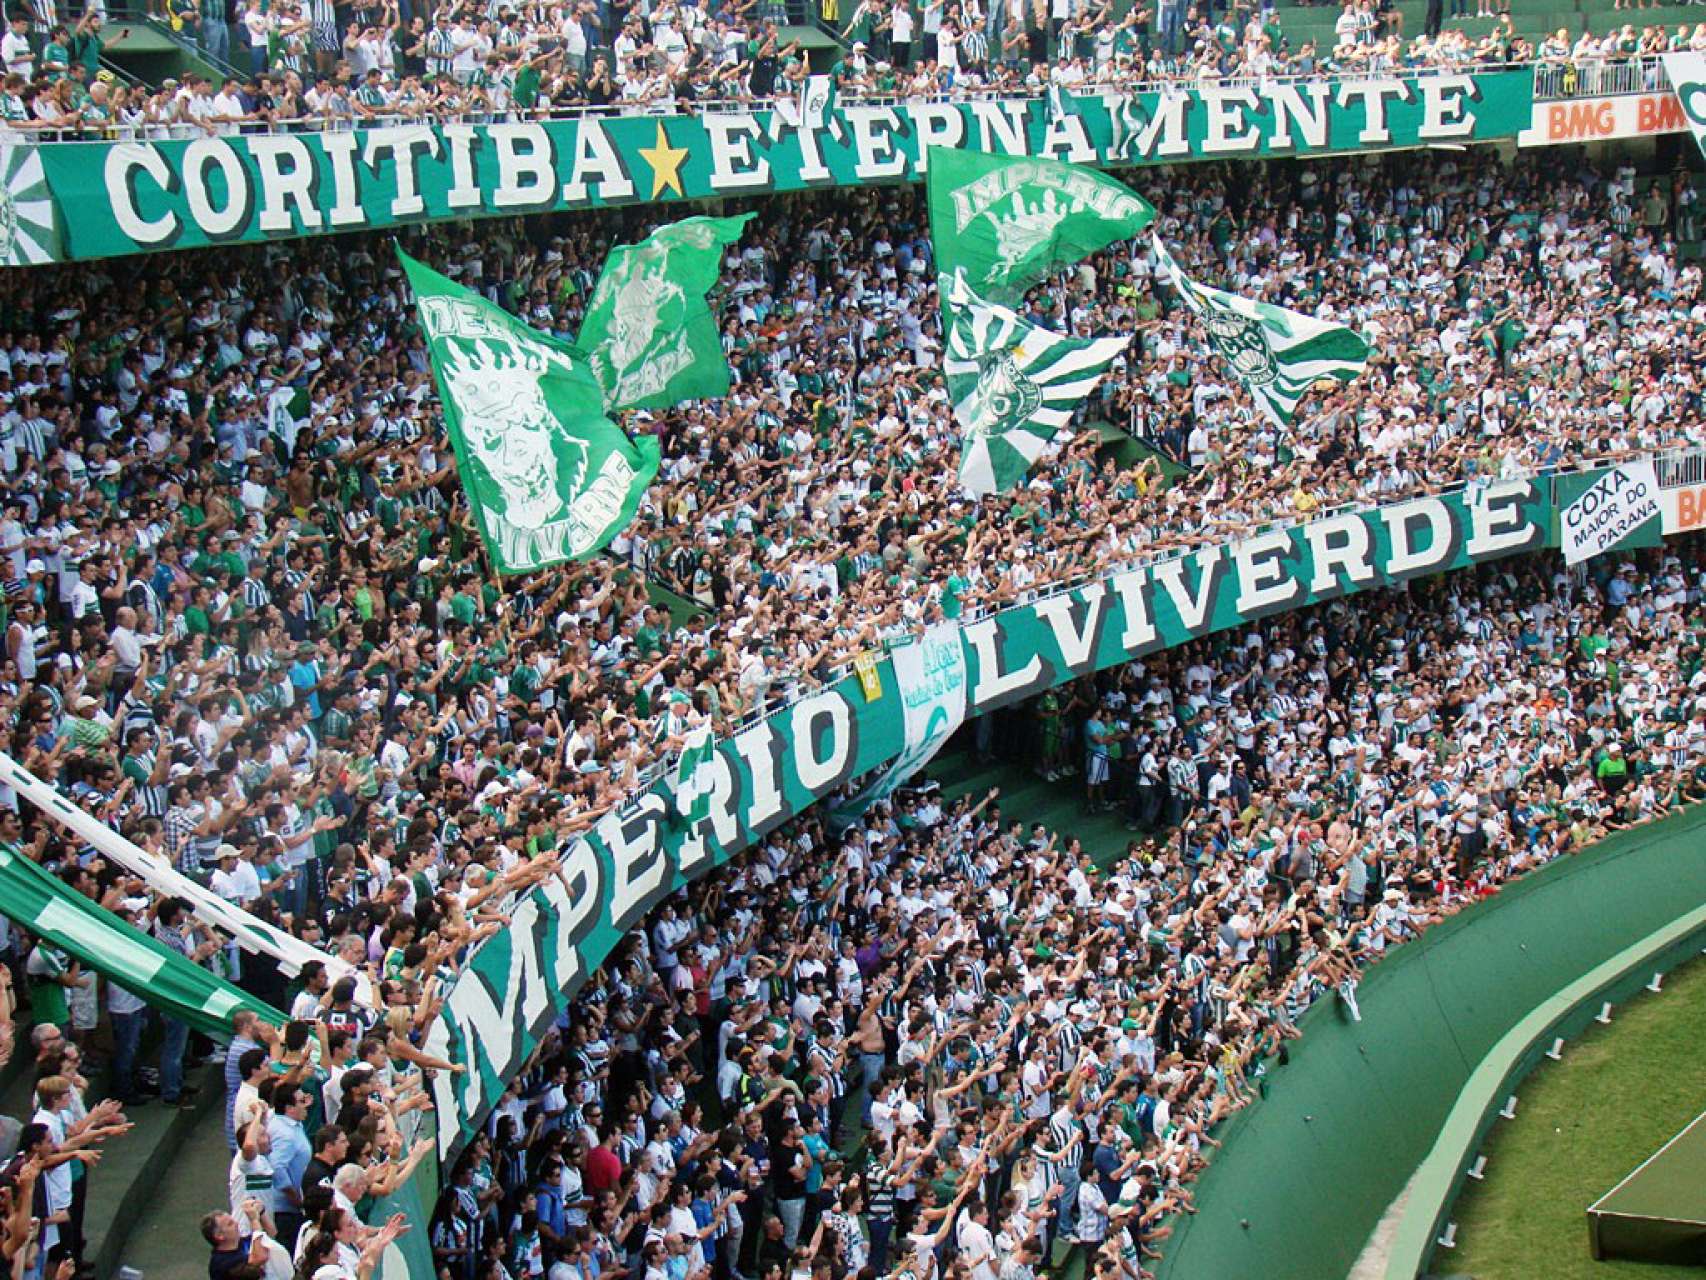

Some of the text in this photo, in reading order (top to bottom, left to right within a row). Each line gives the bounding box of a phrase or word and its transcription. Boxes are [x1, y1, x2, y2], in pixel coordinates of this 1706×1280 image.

[1548, 101, 1615, 139] BMG
[1638, 95, 1688, 132] BM
[103, 75, 1477, 243] CORITIBA ETERNAMENTE
[1567, 469, 1630, 527] COXA
[1574, 482, 1647, 548] MAIOR DO
[964, 480, 1536, 705] LVIVERDE
